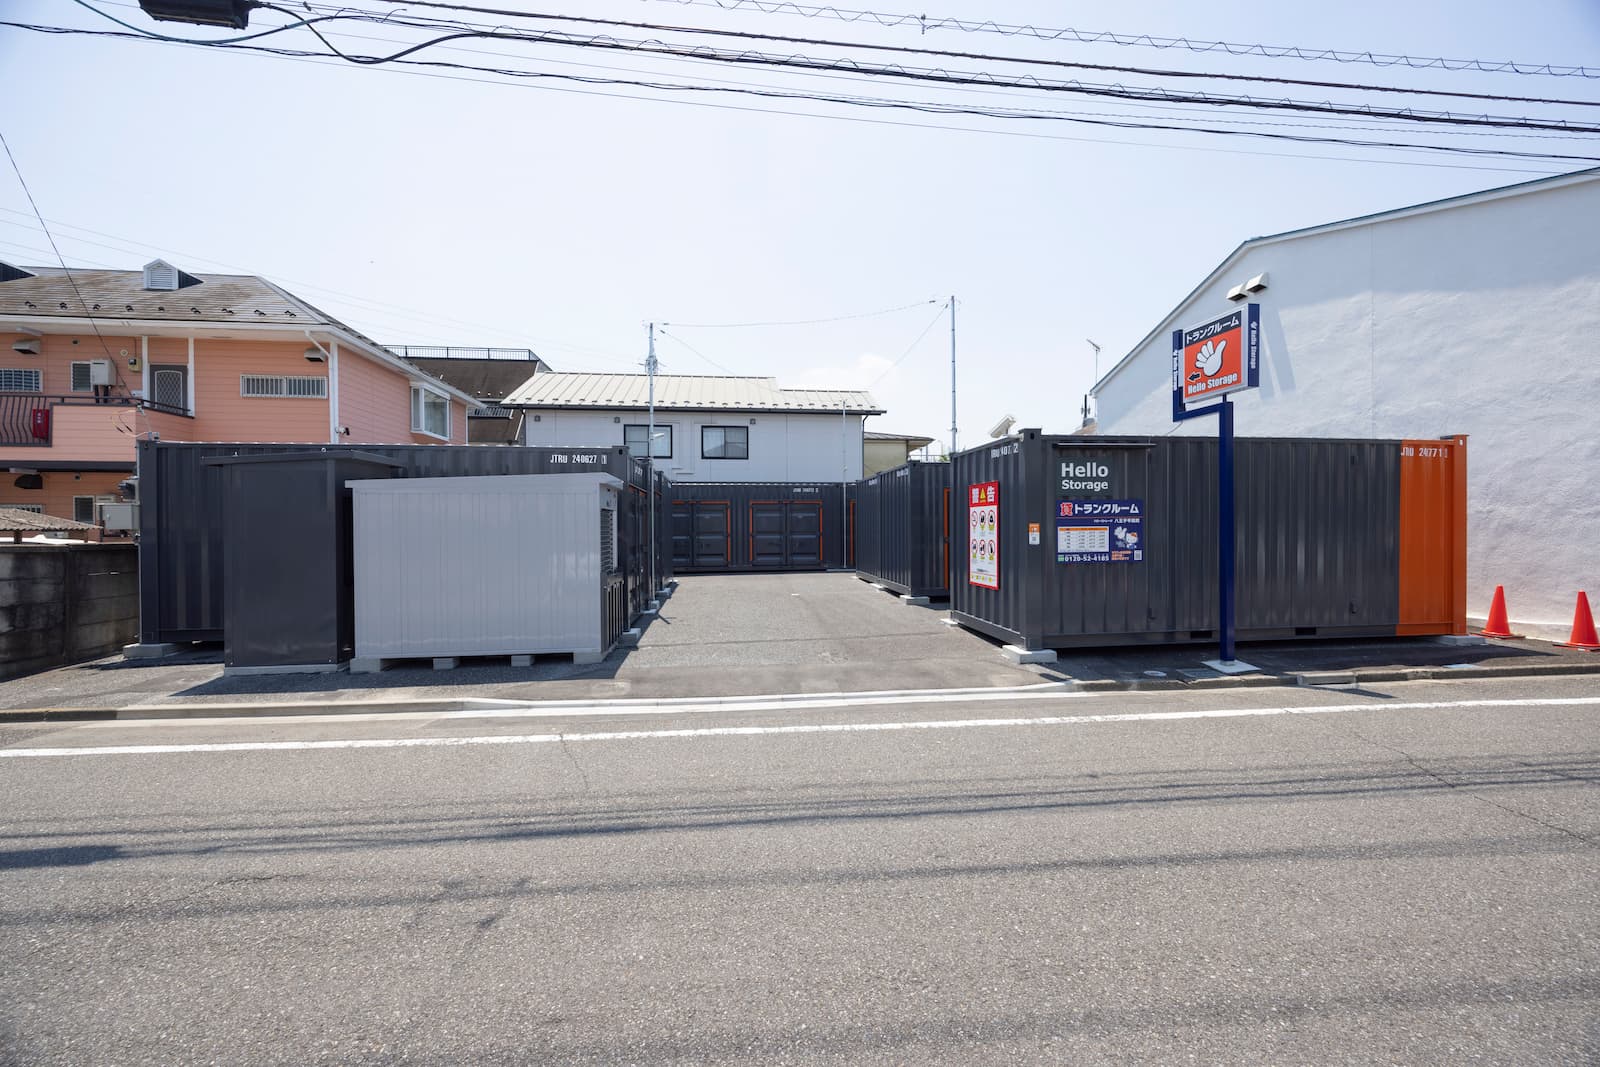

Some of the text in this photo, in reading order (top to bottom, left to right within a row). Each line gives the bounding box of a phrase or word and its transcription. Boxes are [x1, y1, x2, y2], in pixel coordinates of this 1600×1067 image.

[1186, 316, 1239, 344] トランクルーム
[1187, 373, 1238, 394] Hello Storage
[550, 454, 568, 464] JTRU
[571, 454, 598, 464] 240627
[1061, 462, 1109, 477] Hello
[1061, 480, 1109, 491] Storage
